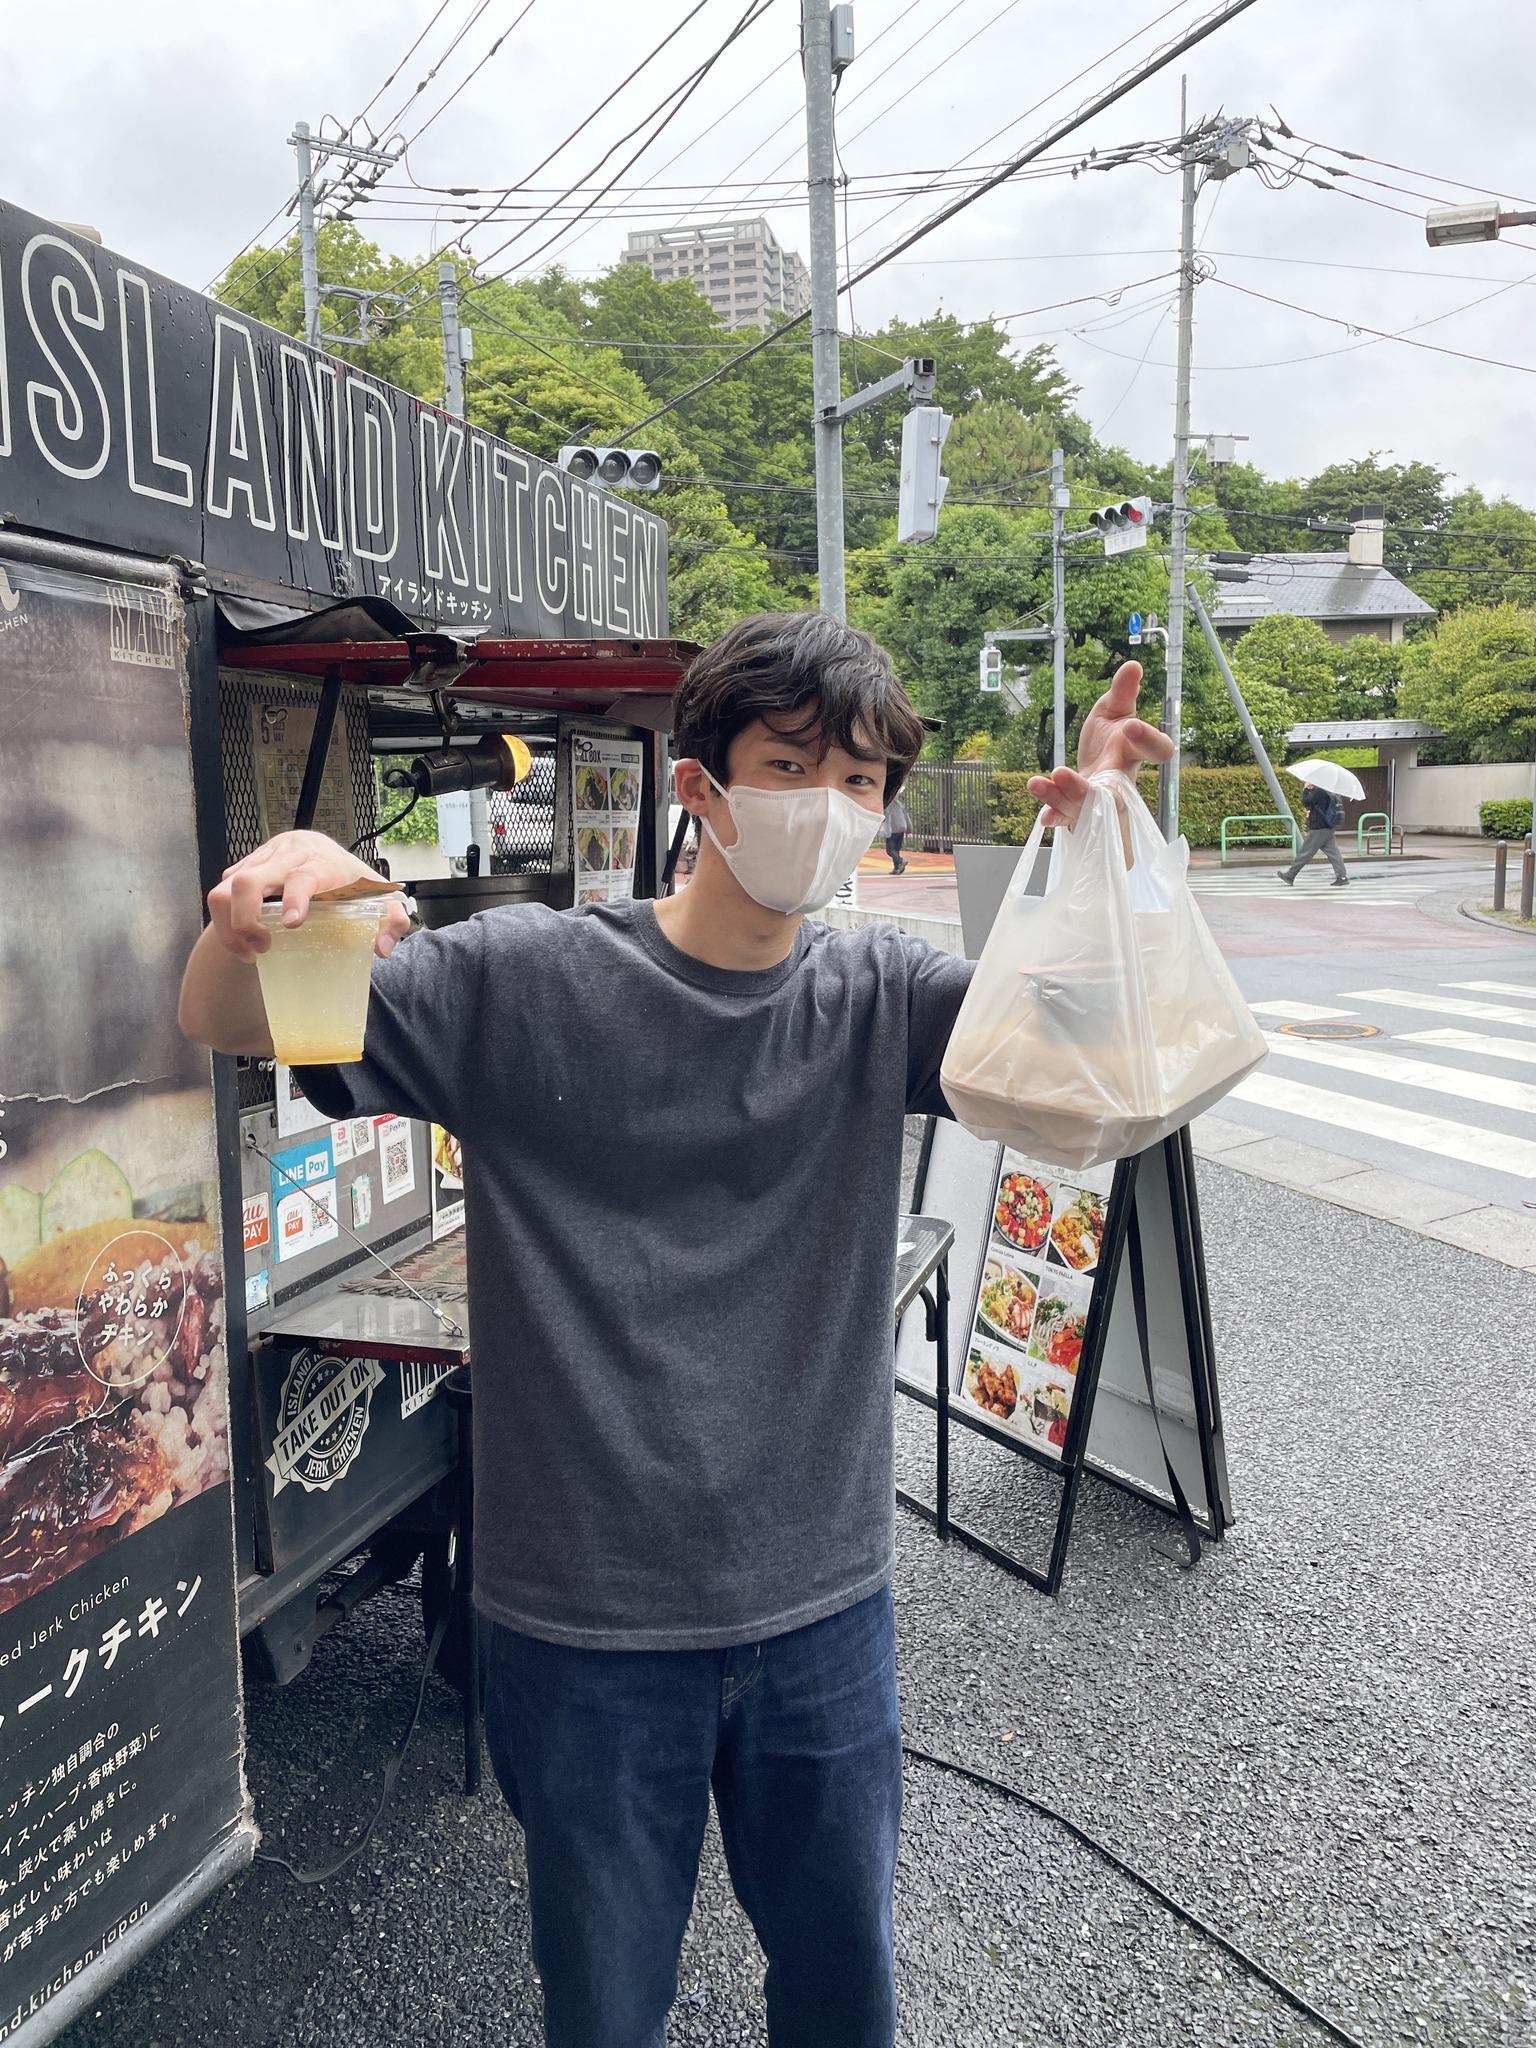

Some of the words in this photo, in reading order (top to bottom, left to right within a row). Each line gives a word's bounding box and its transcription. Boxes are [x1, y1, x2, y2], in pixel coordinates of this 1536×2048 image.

[419, 411, 660, 640] KITCHEN
[378, 574, 492, 621] アイランドキッチン
[113, 649, 172, 667] KITCHEN
[278, 1163, 304, 1187] LINE
[308, 1158, 327, 1178] Pay
[243, 1204, 263, 1222] au
[287, 1220, 300, 1232] PAY
[243, 1222, 263, 1240] PAY
[102, 1262, 171, 1290] ふっくら
[98, 1293, 168, 1319] やわらか
[100, 1323, 153, 1347] チキン
[287, 1357, 312, 1416] ISLAND
[279, 1409, 319, 1462] TAKE
[320, 1380, 348, 1421] OUT
[351, 1358, 370, 1391] OK
[305, 1456, 329, 1478] JERK
[332, 1406, 365, 1471] CHICKEN
[29, 1616, 64, 1650] Jerk
[69, 1575, 130, 1621] Chicken
[0, 1574, 202, 1729] ークチキン
